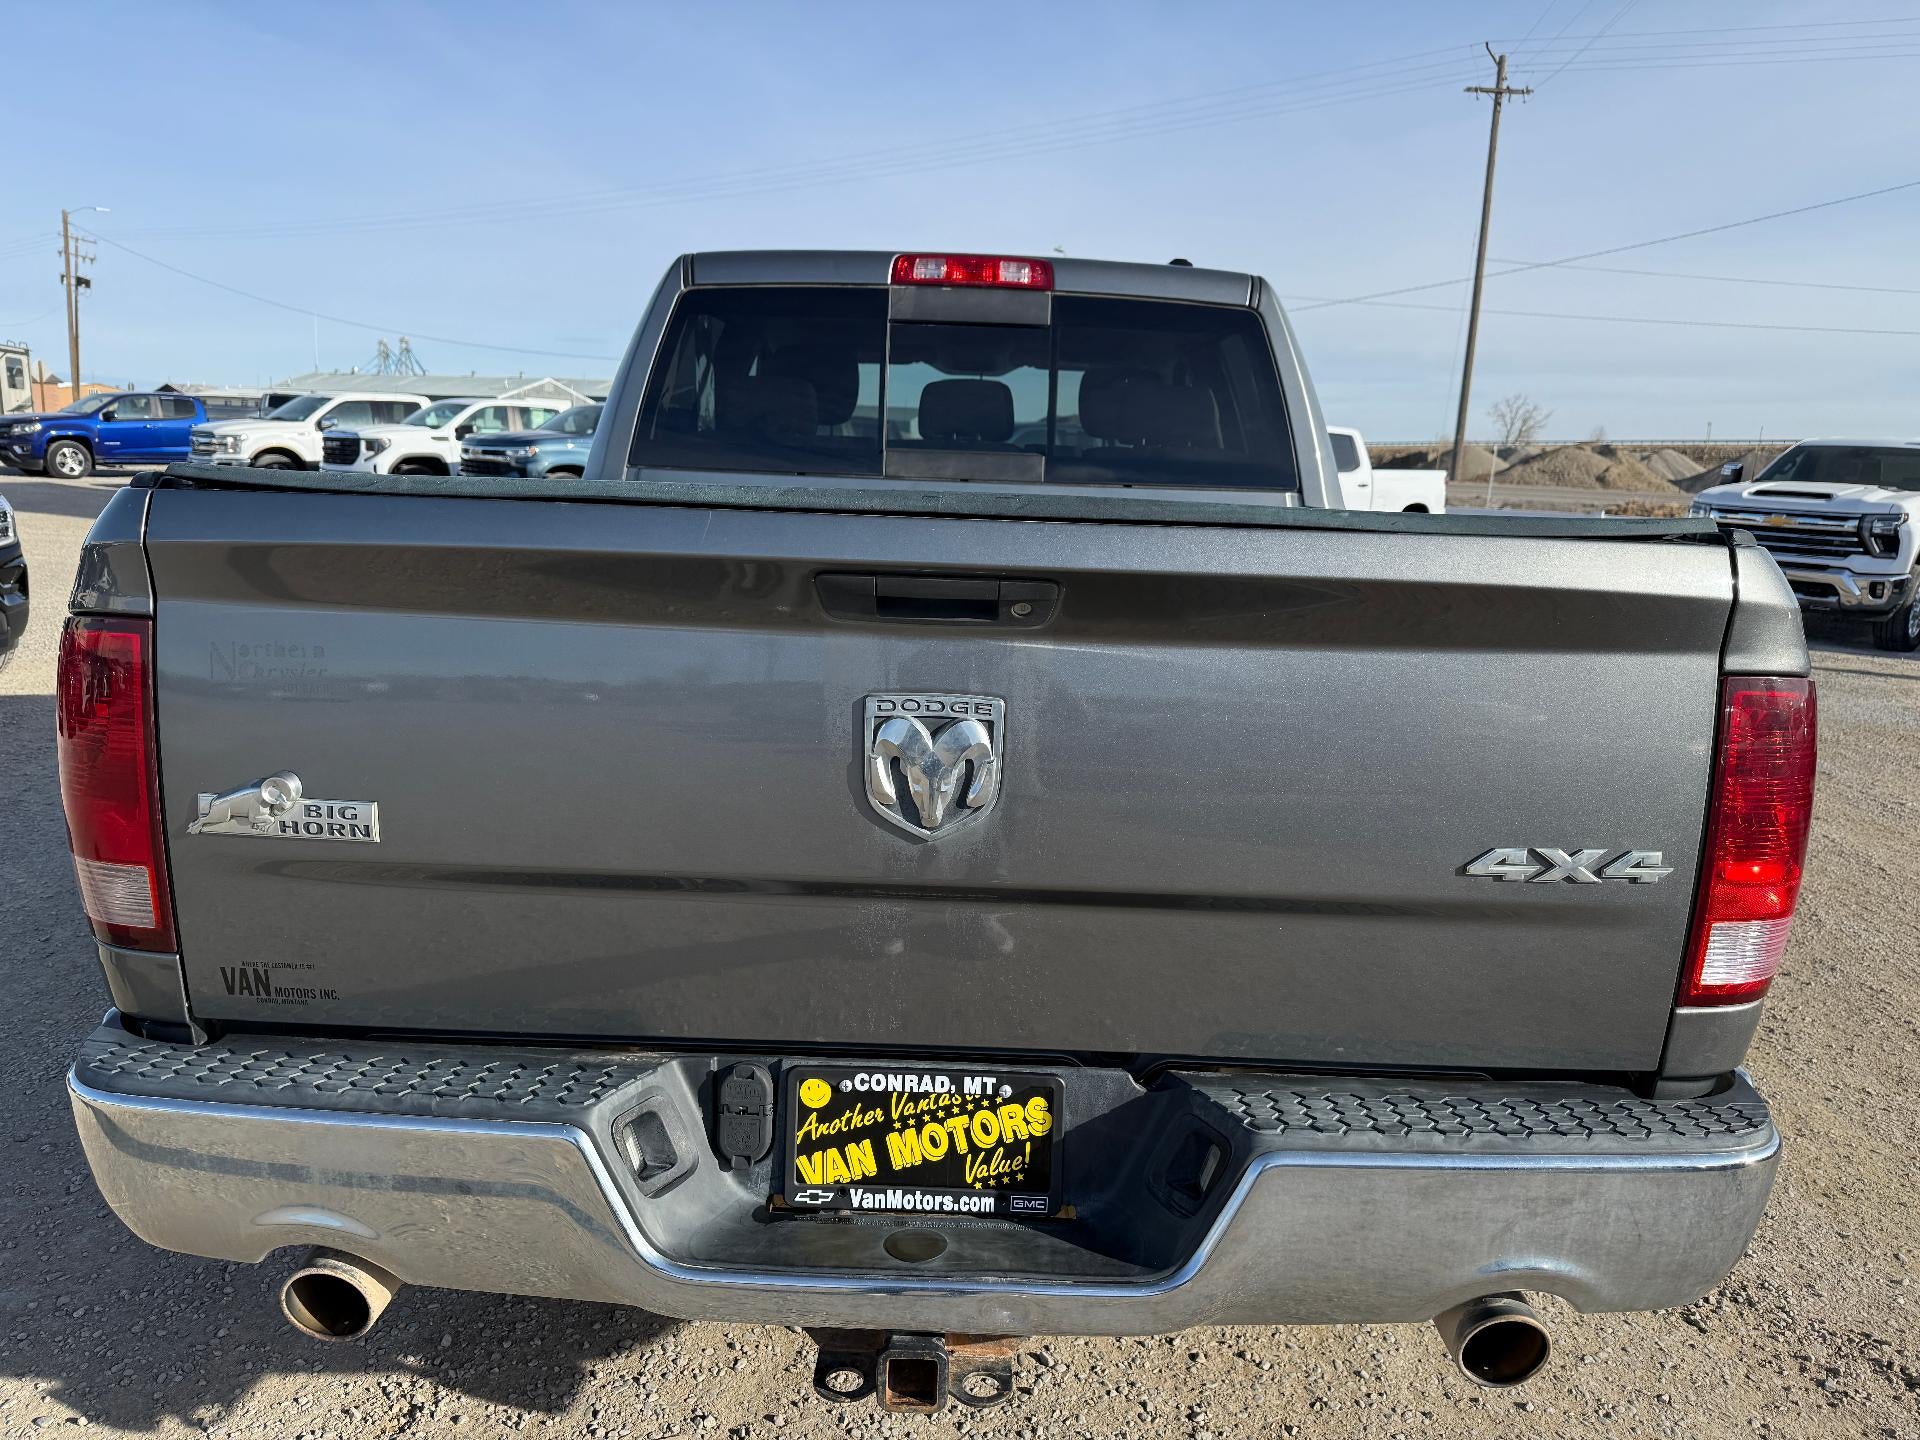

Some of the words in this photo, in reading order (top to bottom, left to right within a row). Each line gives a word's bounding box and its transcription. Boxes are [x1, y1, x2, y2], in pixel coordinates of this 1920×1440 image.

[876, 699, 993, 716] DODGE
[303, 804, 358, 820] BIG
[278, 820, 371, 838] HORN
[219, 967, 272, 997] VAN
[274, 986, 317, 1000] MOTORS
[319, 989, 340, 1001] INC.
[854, 1073, 956, 1093] CONRAD,
[963, 1076, 997, 1096] MT
[796, 1103, 885, 1144] Another
[796, 1139, 877, 1185] VAN
[886, 1096, 1053, 1171] MOTORS
[965, 1141, 1031, 1184] Value!
[850, 1189, 995, 1213] VanMotors.com
[1013, 1200, 1046, 1210] GMC
